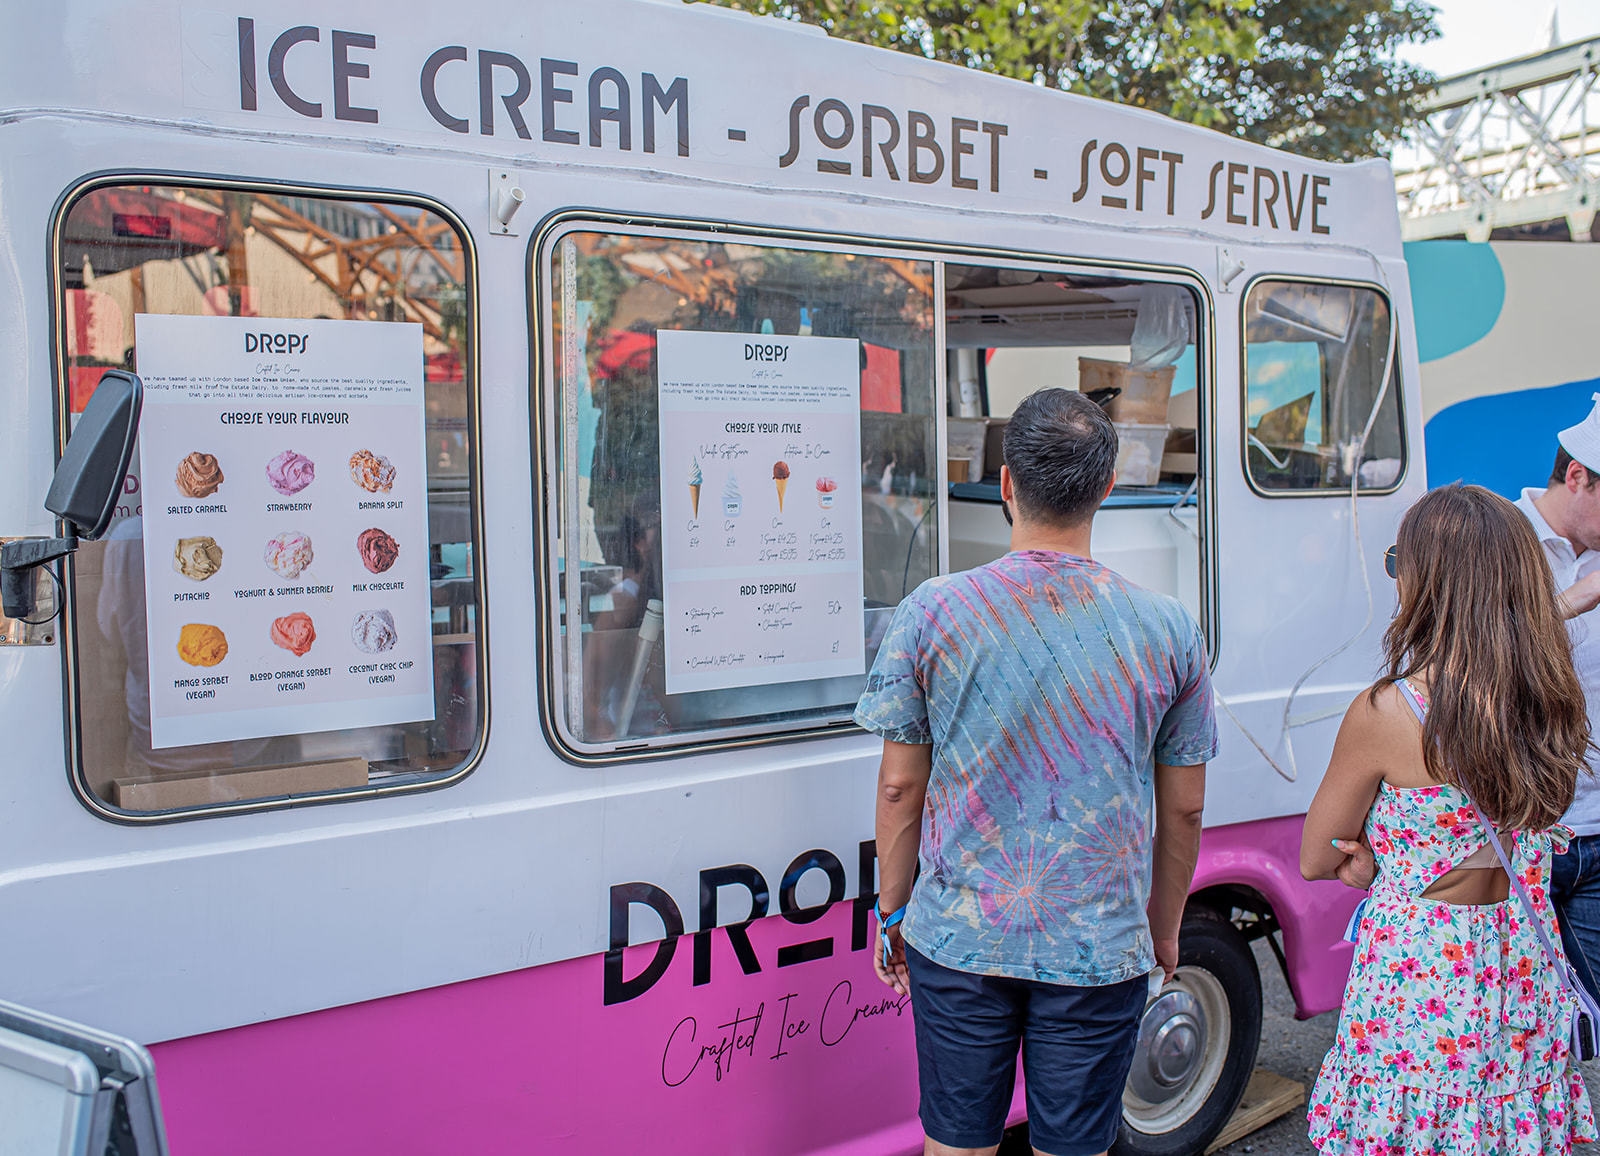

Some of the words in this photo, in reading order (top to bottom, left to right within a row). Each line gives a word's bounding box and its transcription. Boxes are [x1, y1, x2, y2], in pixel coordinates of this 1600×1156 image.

[238, 16, 379, 124] ICE
[420, 45, 690, 158] CREAM
[778, 94, 1009, 193] SORBET
[1072, 138, 1184, 216] SOFT
[1201, 160, 1332, 235] SERVE
[245, 332, 309, 354] DROPS
[744, 343, 789, 362] DROPS
[220, 411, 264, 425] CHOOSE
[266, 412, 298, 425] YOUR
[301, 412, 350, 425] FLAVOUR
[725, 422, 755, 434] CHOOSE
[757, 423, 779, 434] YOUR
[781, 423, 802, 434] STYLE
[167, 505, 193, 515] SALTED
[195, 504, 228, 514] CARAMEL
[266, 502, 313, 512] STRAWBERRY
[358, 501, 385, 510] BANANA
[387, 500, 404, 510] SPLIT
[234, 588, 266, 599] YOGHURT
[268, 588, 276, 596] &
[276, 586, 304, 596] SUMMER
[306, 584, 334, 594] BERRIES
[352, 583, 368, 592] MILK
[369, 582, 405, 591] CHOCOLATE
[740, 585, 757, 596] ADD
[760, 582, 797, 595] TOPPINGS
[174, 591, 210, 601] PISTACHIO
[348, 663, 378, 674] COCONUT
[379, 662, 398, 672] CHOC
[398, 660, 414, 670] CHIP
[250, 672, 273, 682] BLOOD
[274, 669, 305, 680] ORANGE
[306, 668, 332, 678] SORBET
[368, 674, 396, 685] (VEGAN)
[174, 678, 200, 688] MANGO
[202, 676, 229, 686] SORBET
[277, 681, 306, 693] (VEGAN)
[185, 689, 216, 700] (VEGAN)
[661, 1001, 765, 1087] Crafted
[770, 993, 811, 1061] Ice
